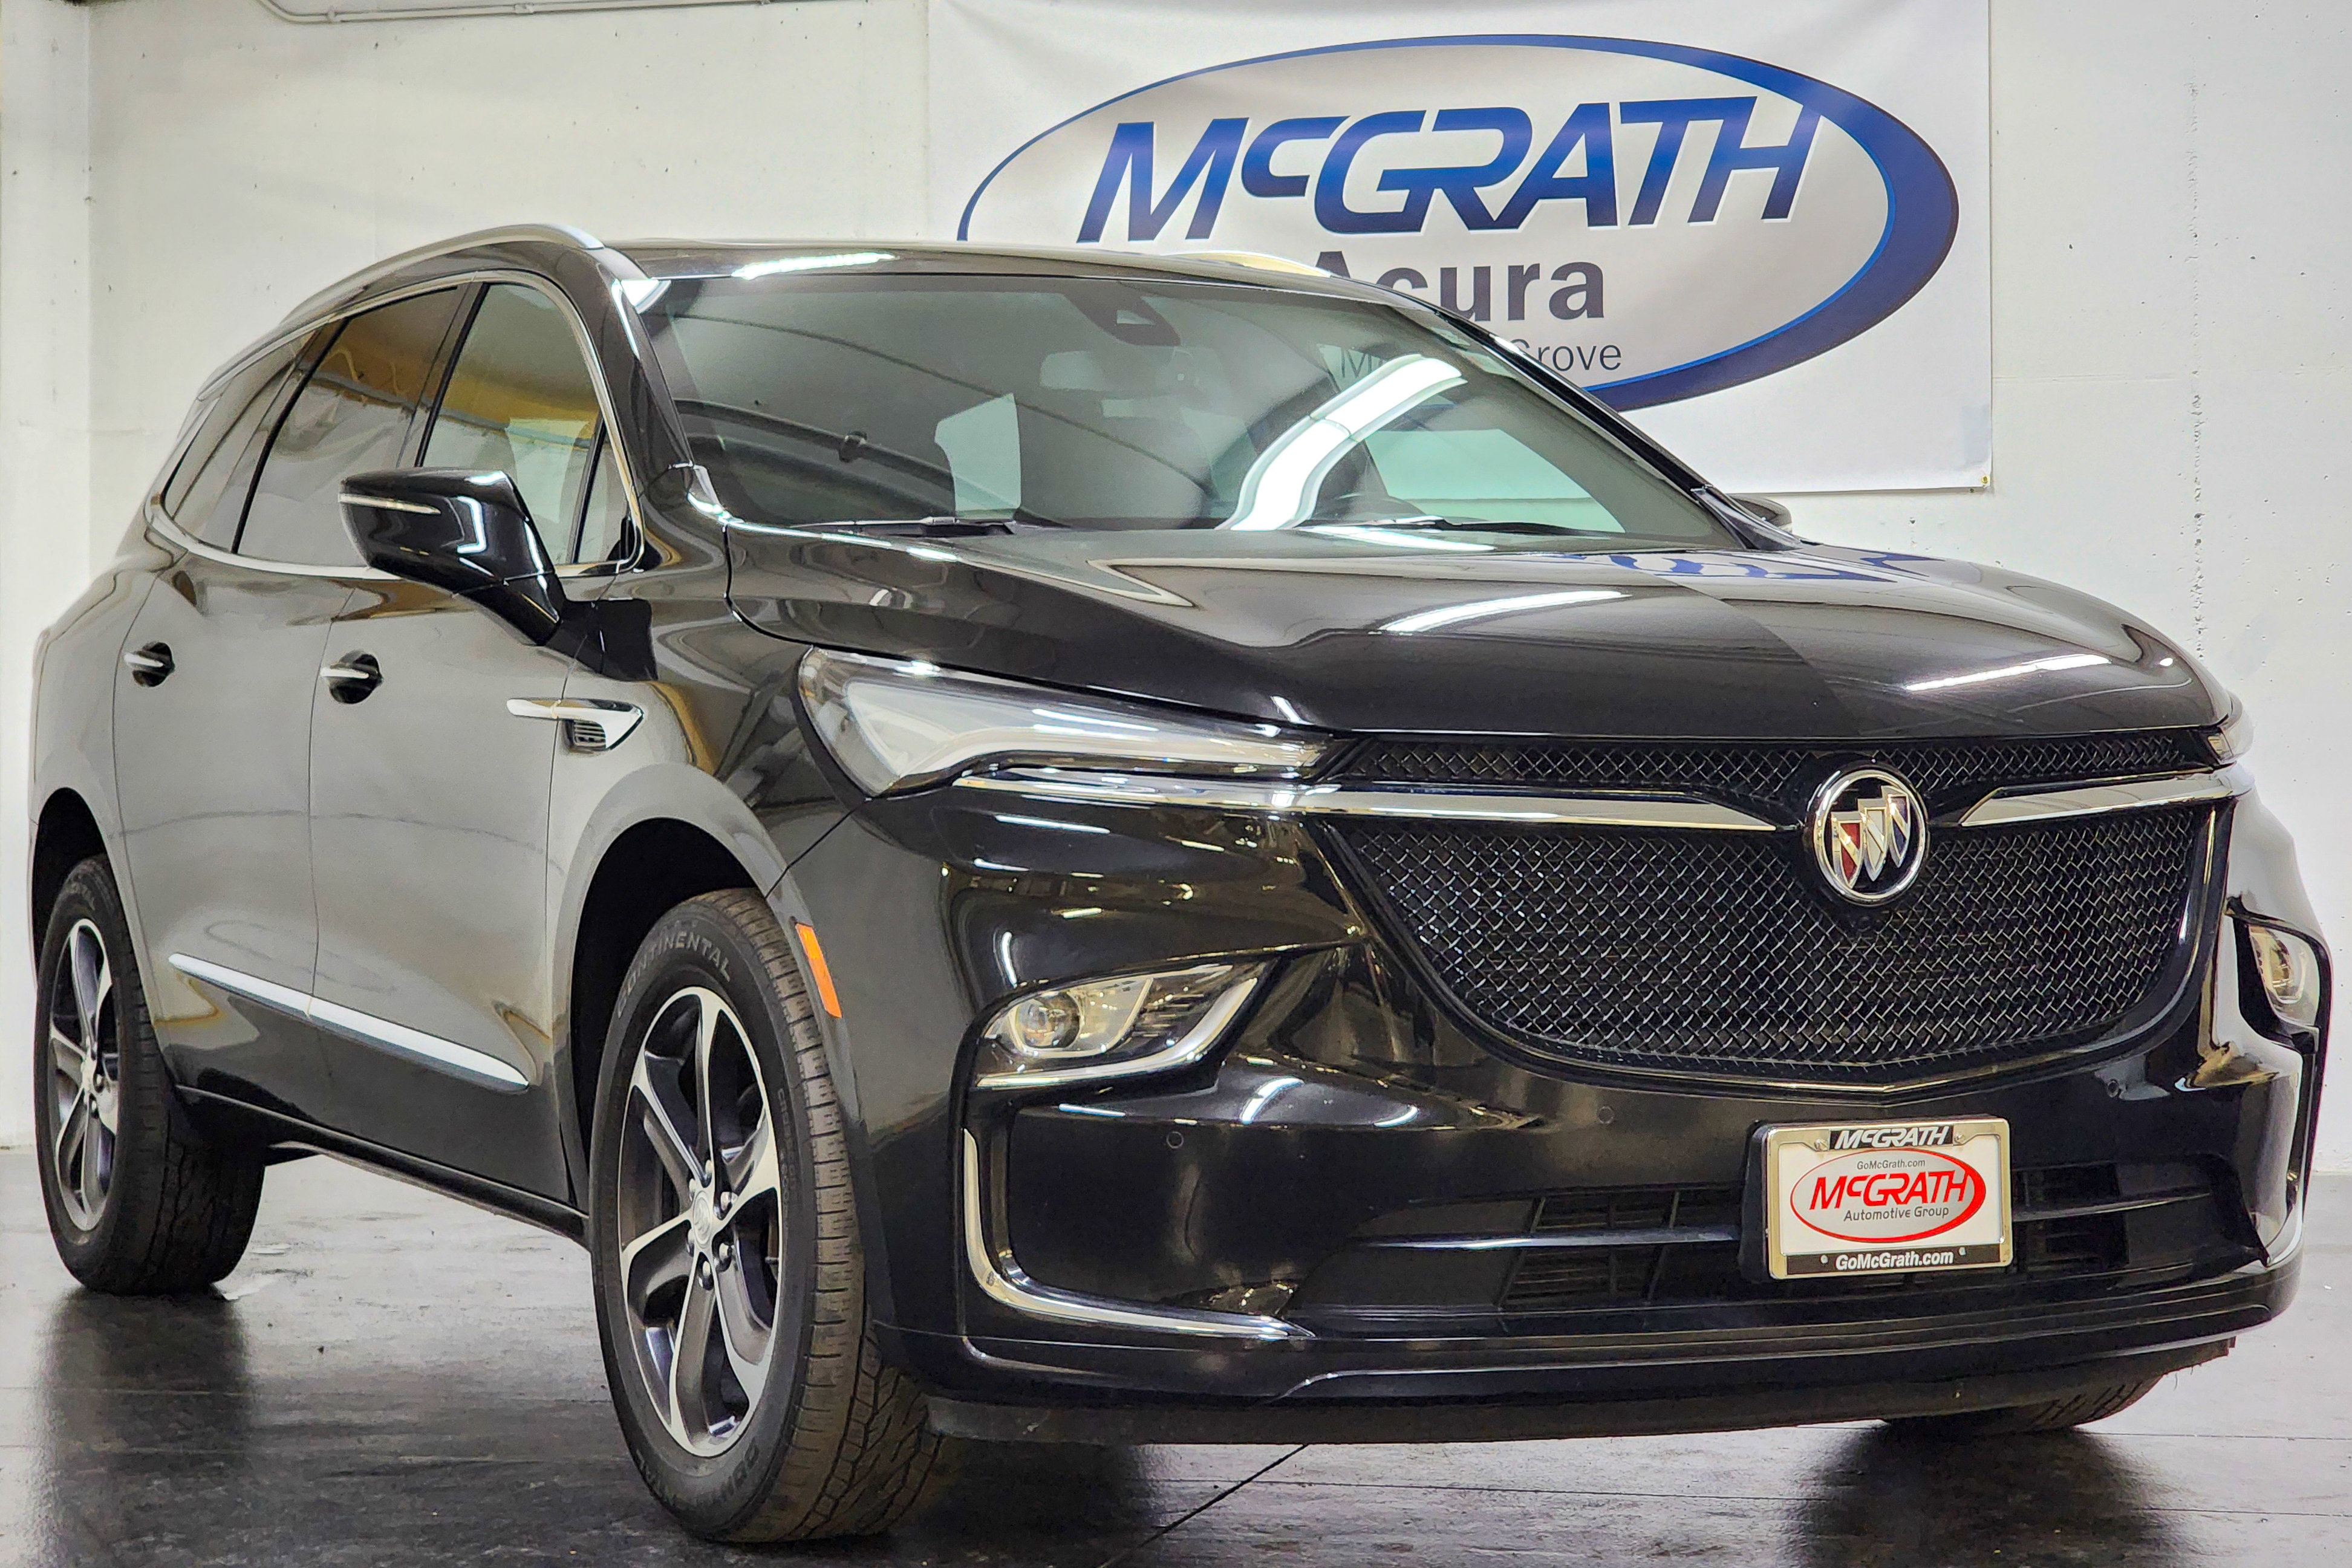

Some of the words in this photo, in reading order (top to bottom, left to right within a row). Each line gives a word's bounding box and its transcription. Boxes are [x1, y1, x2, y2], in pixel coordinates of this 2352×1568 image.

[617, 930, 731, 1018] CONTINENTAL
[1857, 1159, 1926, 1170] GoMcGrath.com
[1843, 1208, 1911, 1222] Automotive
[1914, 1207, 1949, 1218] Group
[1836, 1251, 1954, 1270] GoMcGrath.com
